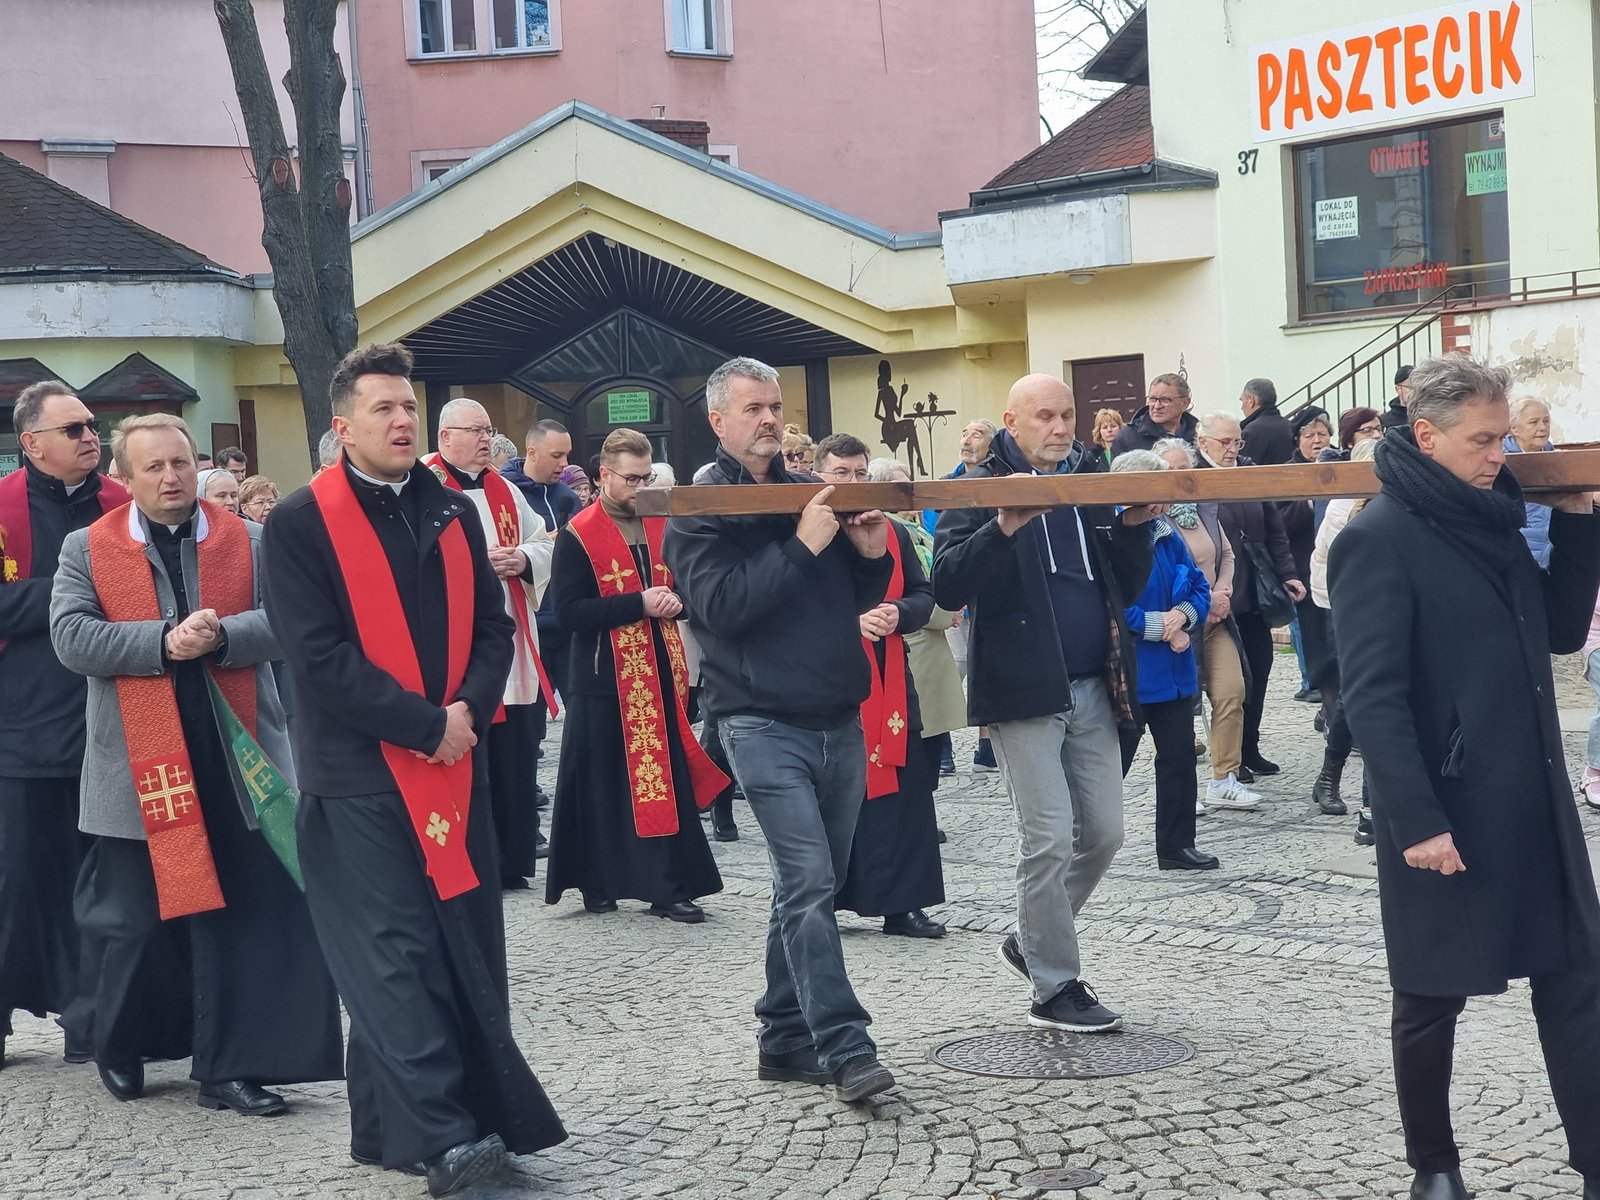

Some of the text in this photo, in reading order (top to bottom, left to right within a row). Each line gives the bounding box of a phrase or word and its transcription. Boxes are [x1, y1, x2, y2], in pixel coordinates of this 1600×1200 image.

[1258, 1, 1522, 130] PASZTECIK
[1238, 148, 1259, 175] 37
[1369, 140, 1430, 174] OTWARTE
[1320, 200, 1353, 211] LOKAL DO
[1322, 223, 1331, 231] od
[1363, 262, 1448, 296] ZAPRASZAMY
